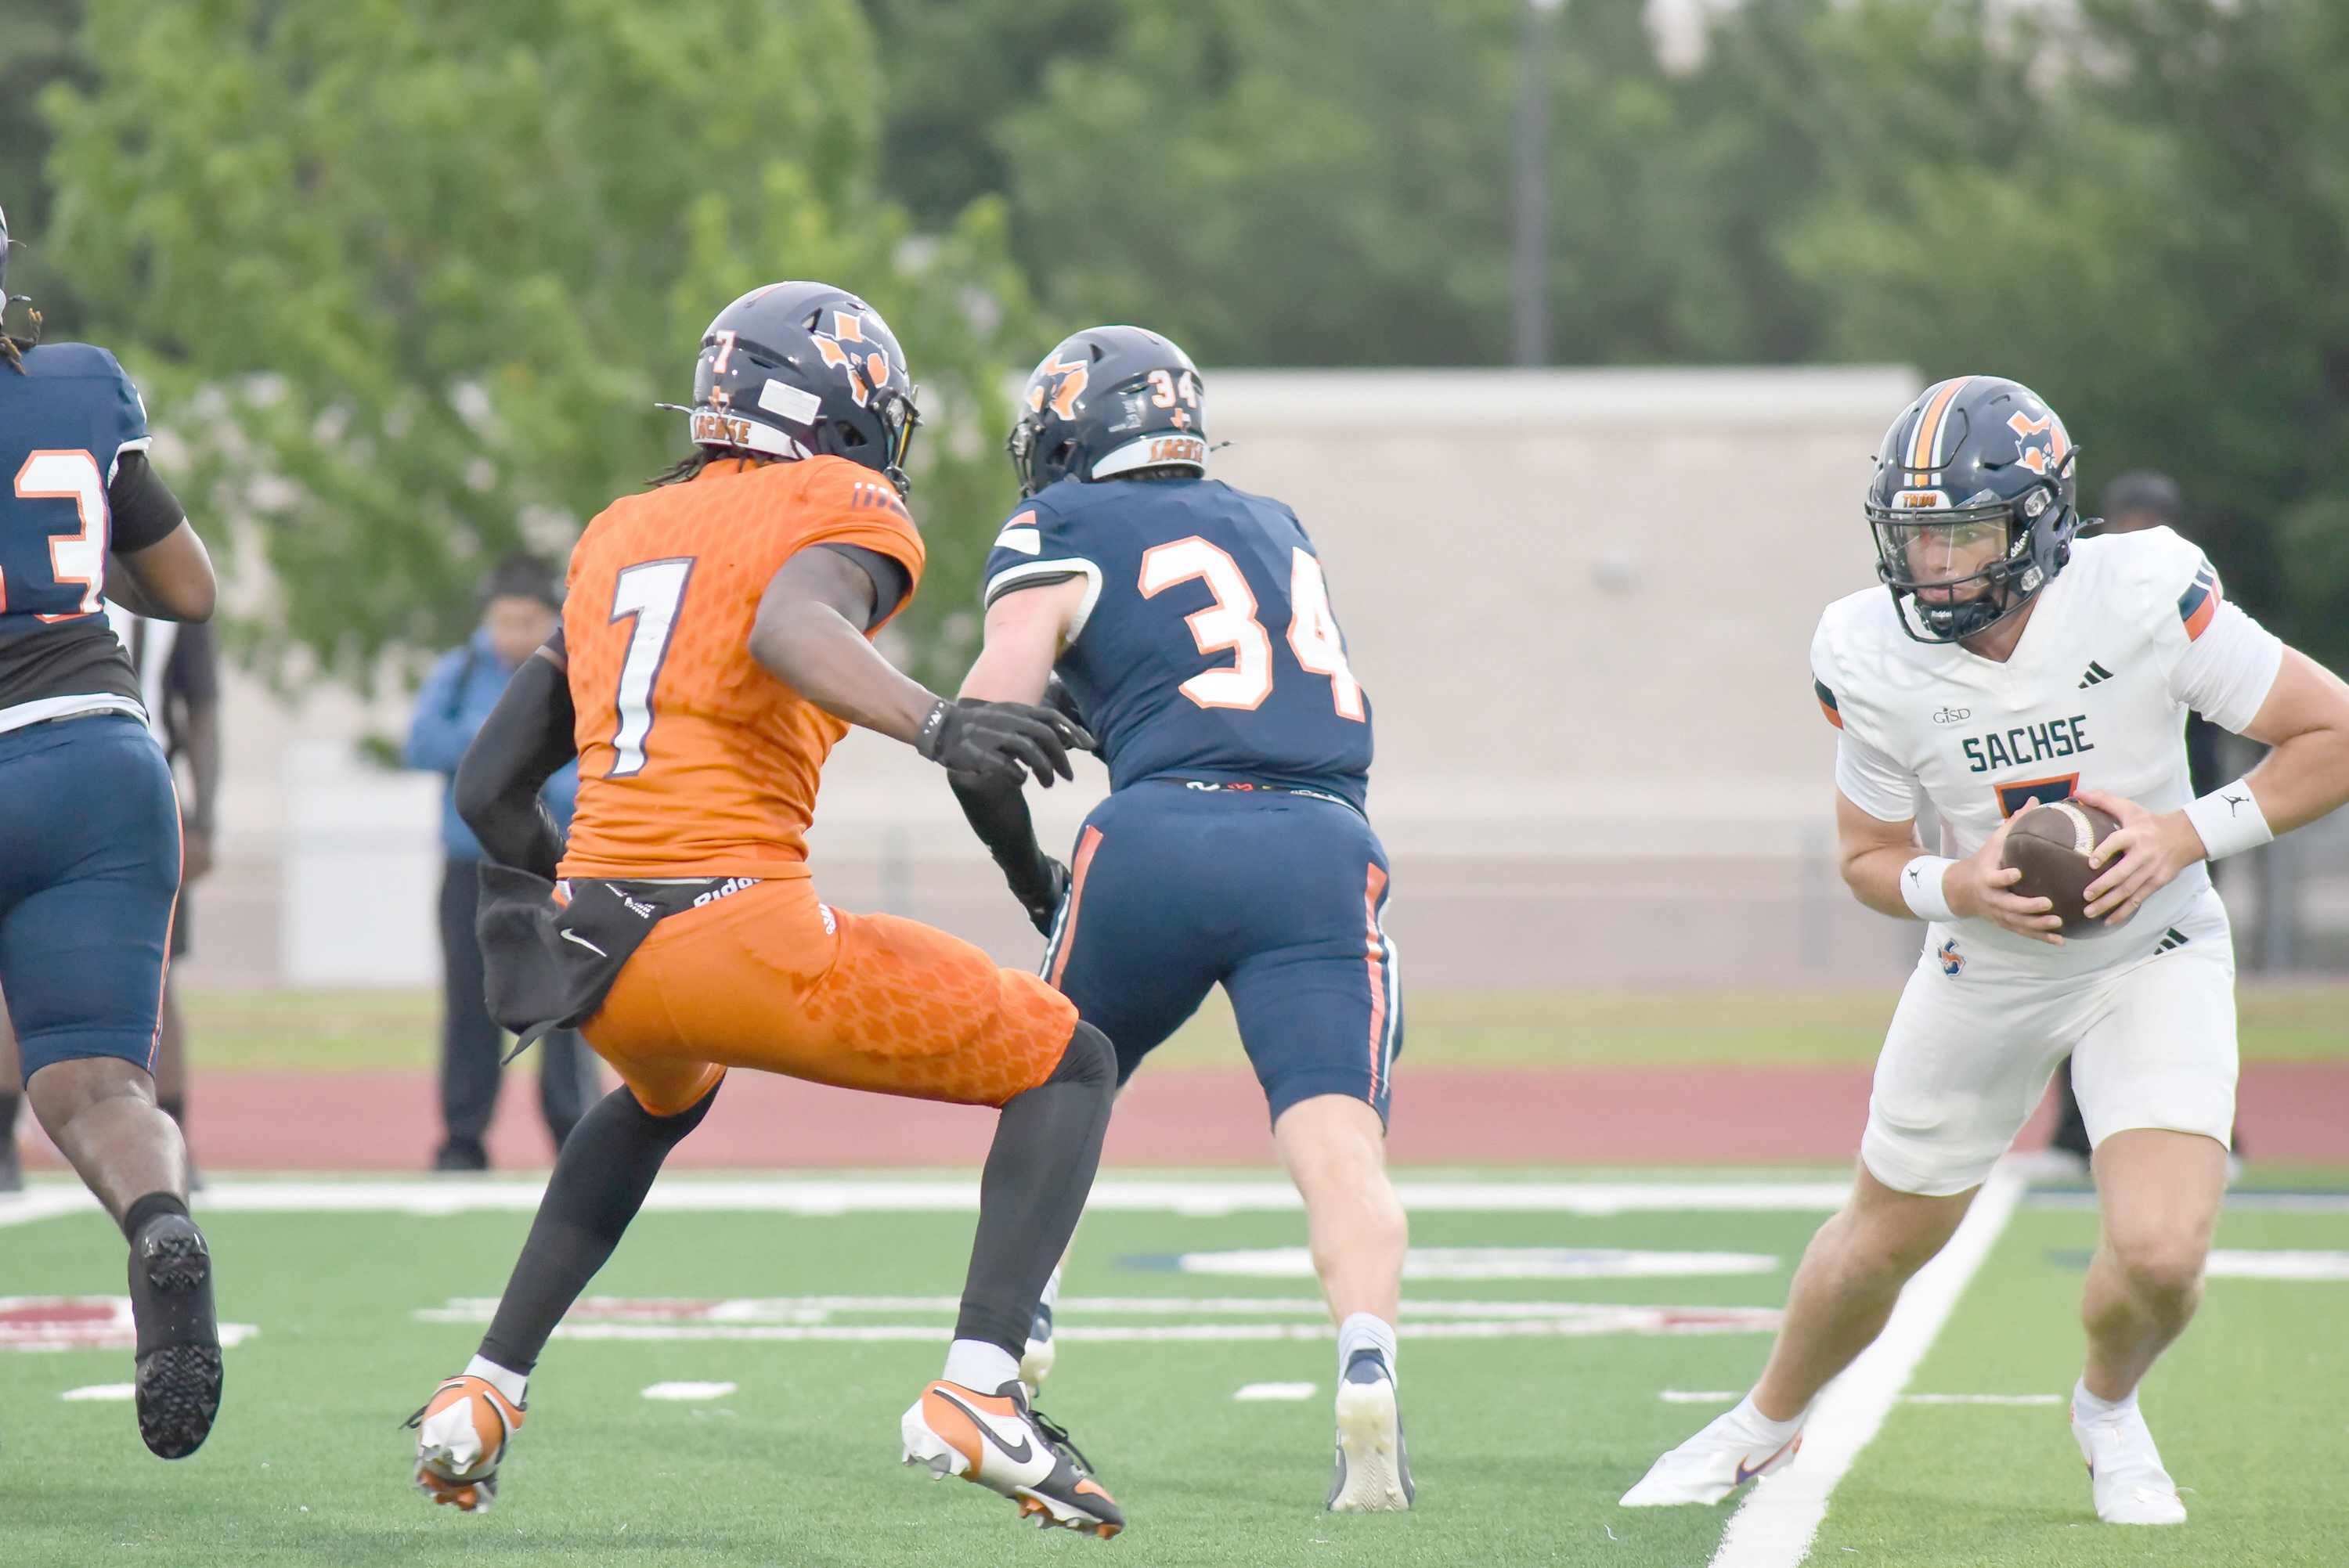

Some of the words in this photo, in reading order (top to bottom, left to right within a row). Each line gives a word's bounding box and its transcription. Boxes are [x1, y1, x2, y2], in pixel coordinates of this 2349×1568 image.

[713, 330, 736, 373] 7
[1147, 369, 1196, 409] 34
[0, 449, 107, 624] 3
[603, 556, 699, 779] 7
[1137, 535, 1366, 723] 34
[1961, 714, 2095, 773] SACHSE
